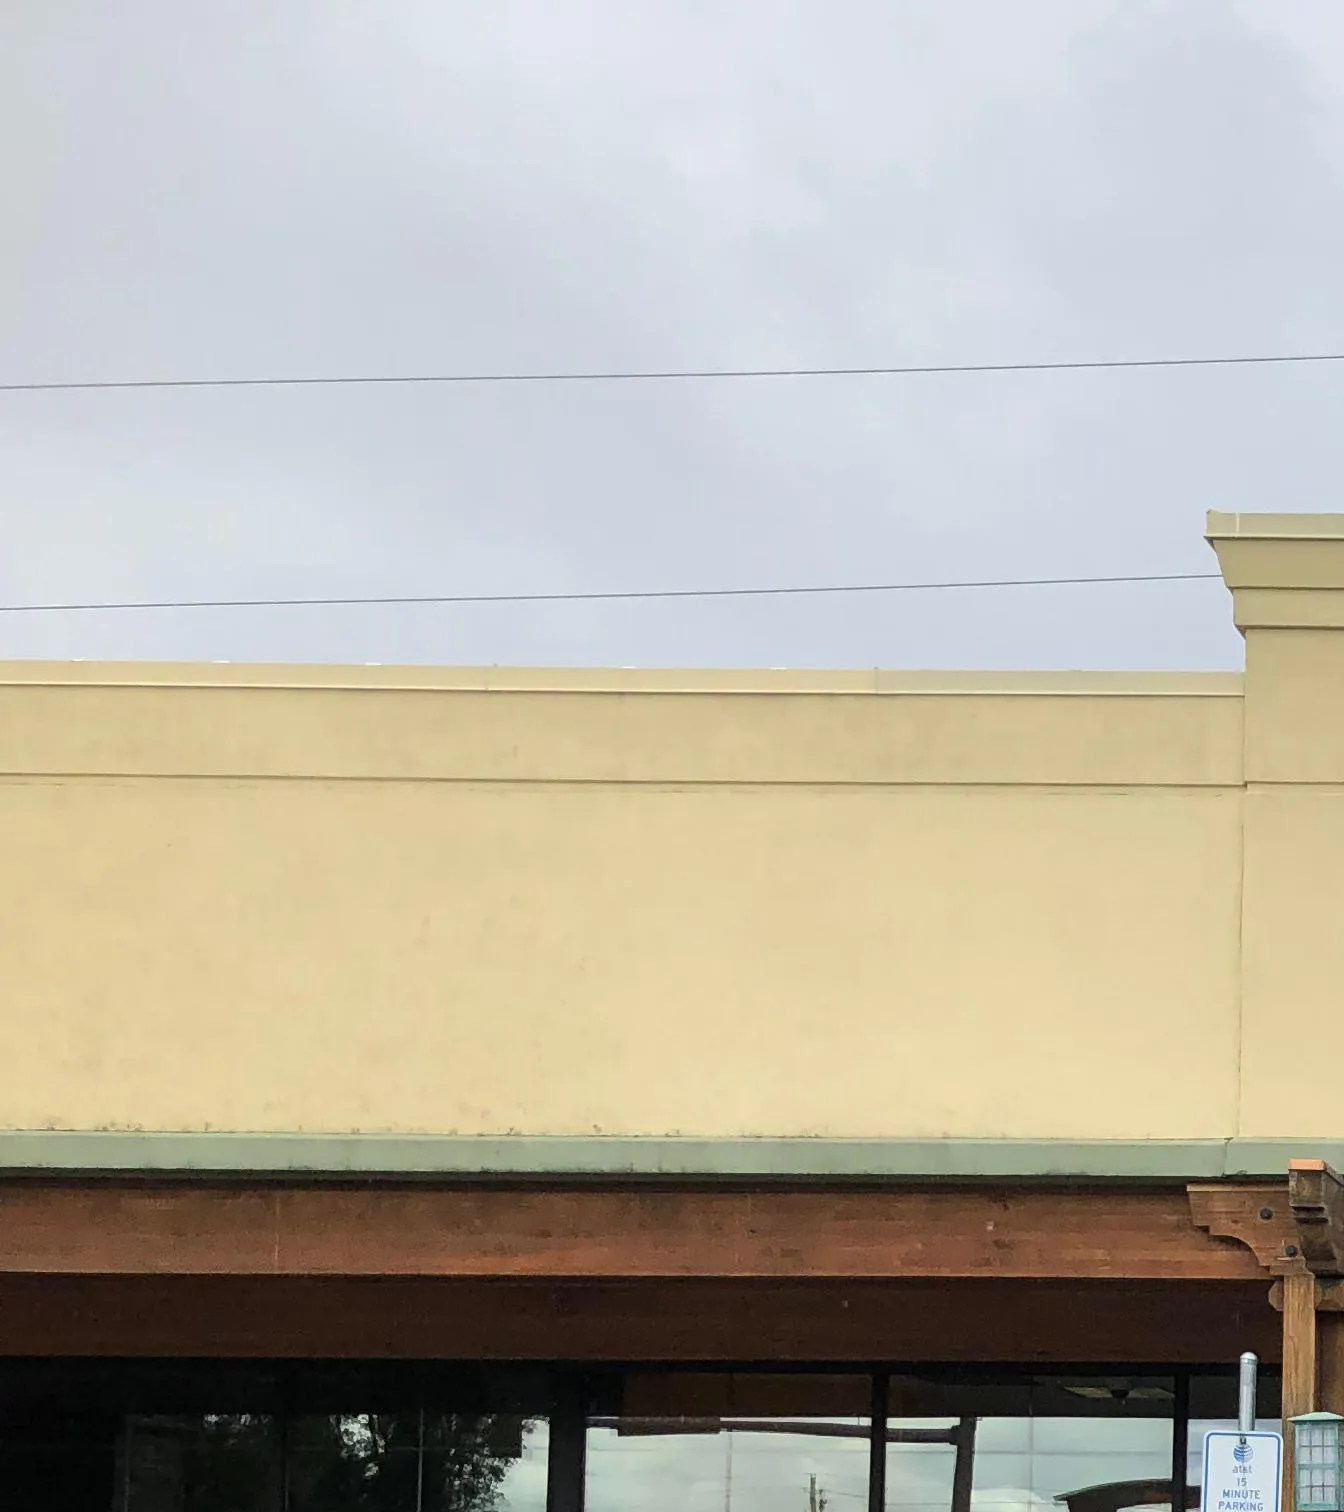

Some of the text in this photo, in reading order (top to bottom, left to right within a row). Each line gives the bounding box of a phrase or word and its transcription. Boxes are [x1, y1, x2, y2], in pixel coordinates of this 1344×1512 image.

[1236, 1478, 1248, 1487] 15
[1222, 1489, 1261, 1499] MINUTE
[1218, 1501, 1264, 1511] PARKING
